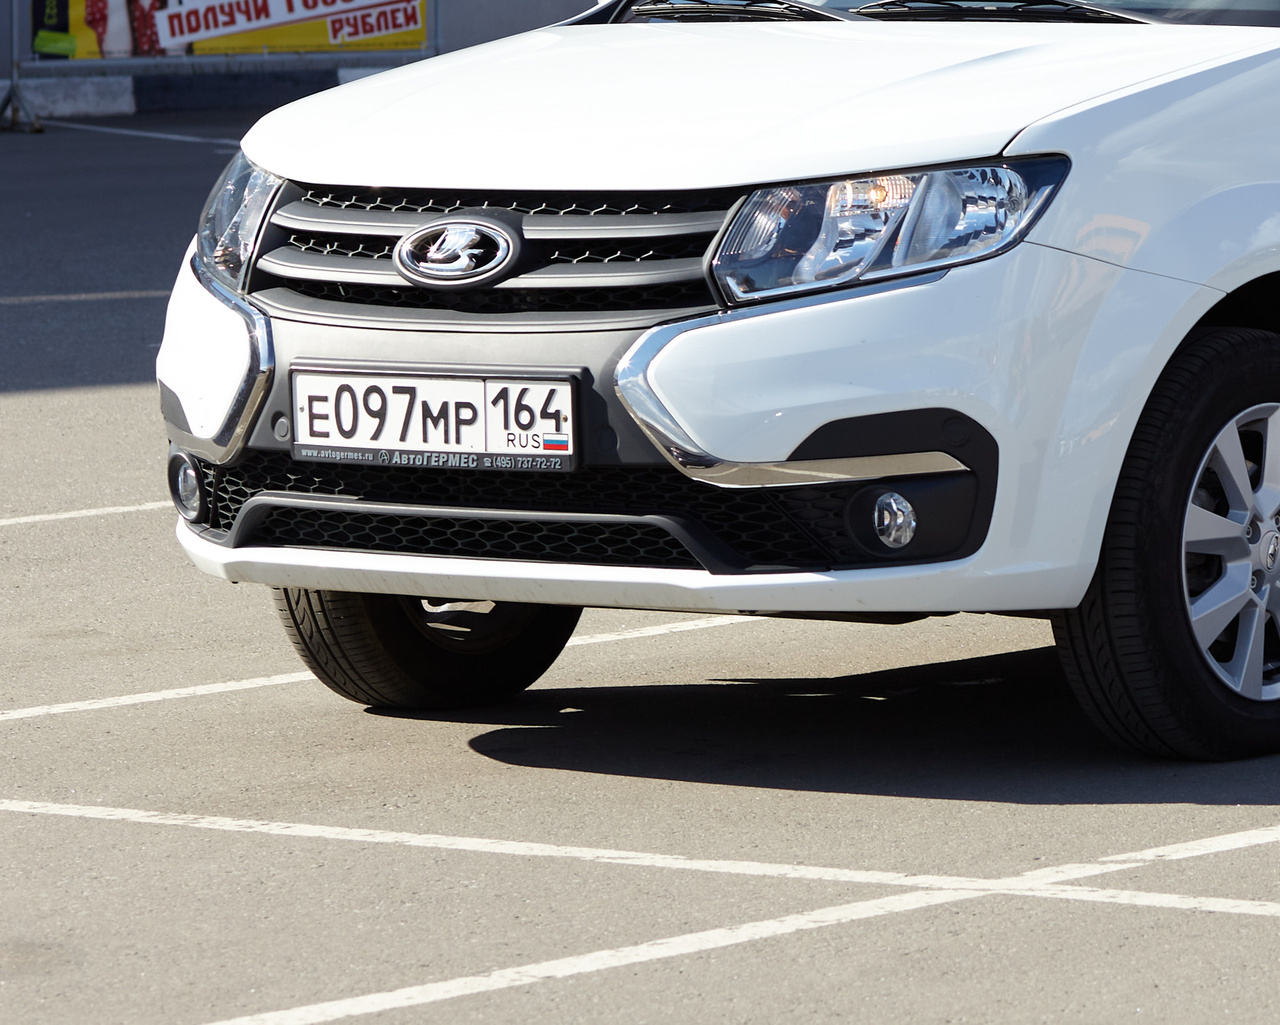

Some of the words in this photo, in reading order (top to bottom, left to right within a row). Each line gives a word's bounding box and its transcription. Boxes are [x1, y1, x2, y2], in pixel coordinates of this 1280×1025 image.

[329, 4, 419, 40] РУБЛЕЙ
[491, 387, 562, 432] 164
[507, 433, 541, 449] RUS
[301, 448, 374, 461] www.avtogermes.ru
[492, 457, 515, 469] (495)
[517, 457, 562, 469] 737-72-72
